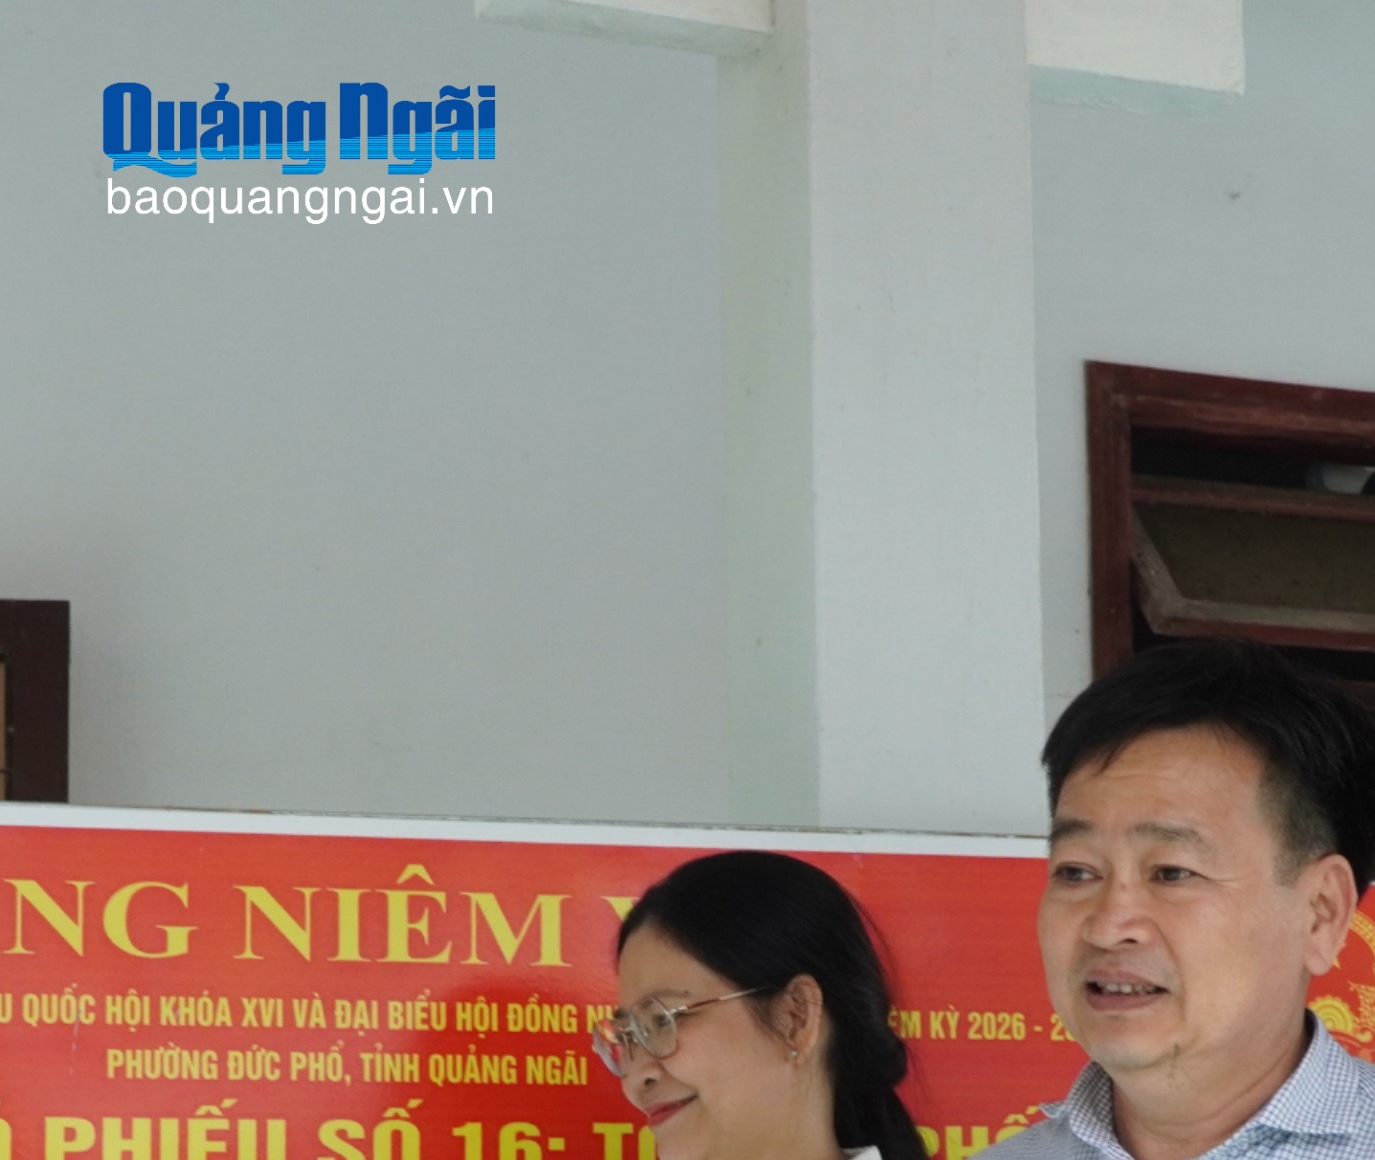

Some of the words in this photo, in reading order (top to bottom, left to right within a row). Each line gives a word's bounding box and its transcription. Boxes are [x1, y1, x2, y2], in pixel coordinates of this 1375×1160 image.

[234, 864, 572, 967] NIÊM
[22, 983, 96, 1027] QUỐC
[106, 990, 151, 1033] HỘI
[160, 992, 232, 1027] KHÓA
[241, 998, 283, 1028] XVI
[293, 992, 326, 1028] VÀ
[335, 1000, 378, 1036] ĐẠI
[389, 989, 447, 1032] BIỂU
[456, 997, 498, 1039] HỘI
[507, 993, 577, 1033] ĐỒNG
[930, 1005, 959, 1040] KỲ
[968, 1012, 1025, 1040] 2026
[107, 1042, 217, 1081] PHƯỜNG
[227, 1044, 280, 1081] ĐỨC
[291, 1040, 351, 1086] PHỔ,
[361, 1045, 419, 1082] TỈNH
[429, 1046, 516, 1086] QUẢNG
[526, 1051, 588, 1085] NGÃI
